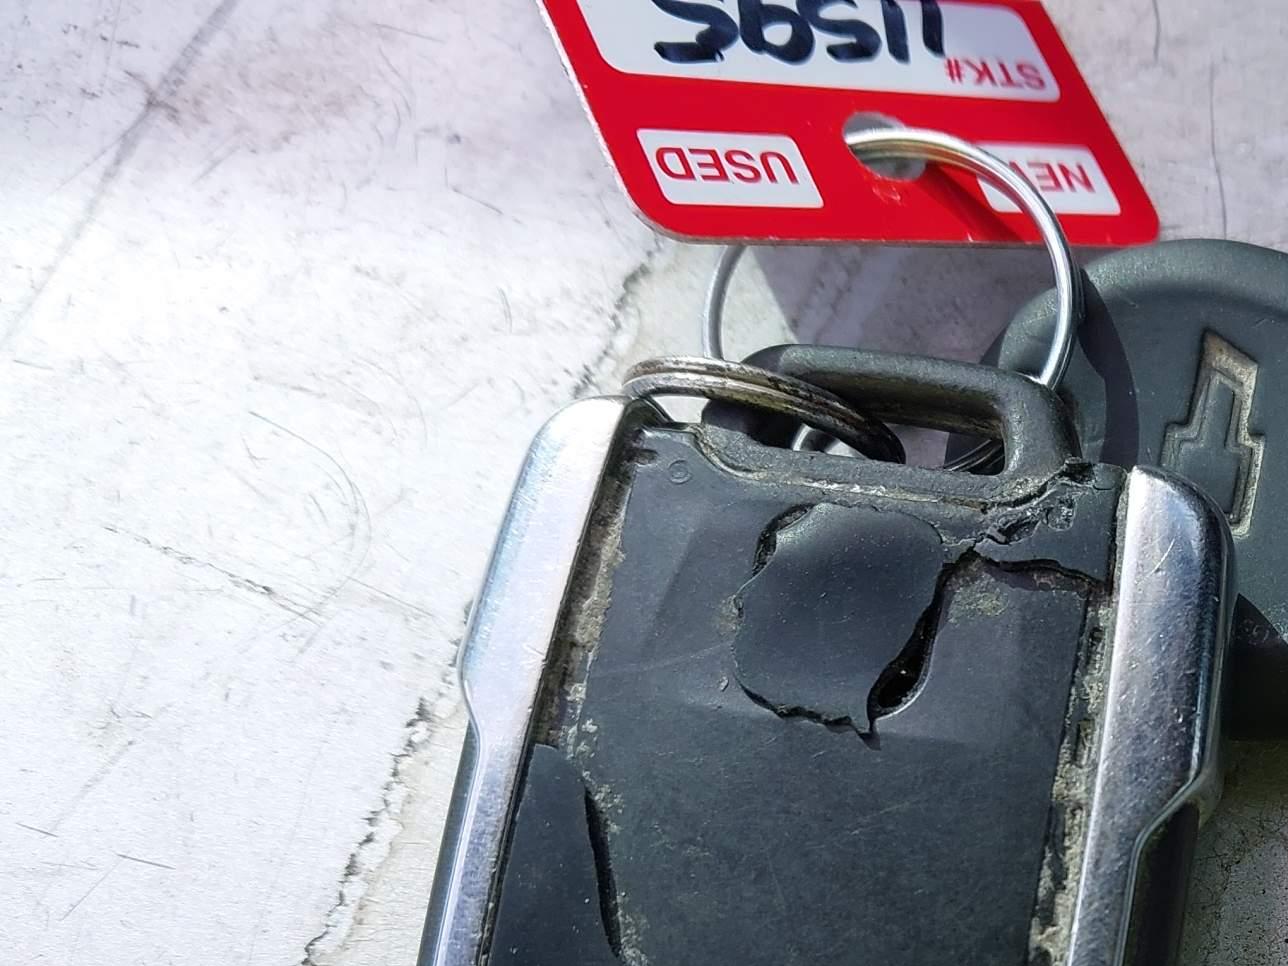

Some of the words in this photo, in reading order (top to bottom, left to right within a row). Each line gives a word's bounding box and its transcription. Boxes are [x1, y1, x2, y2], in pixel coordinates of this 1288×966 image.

[946, 57, 1047, 91] STK#
[656, 147, 800, 186] USED
[1005, 160, 1096, 194] NE
